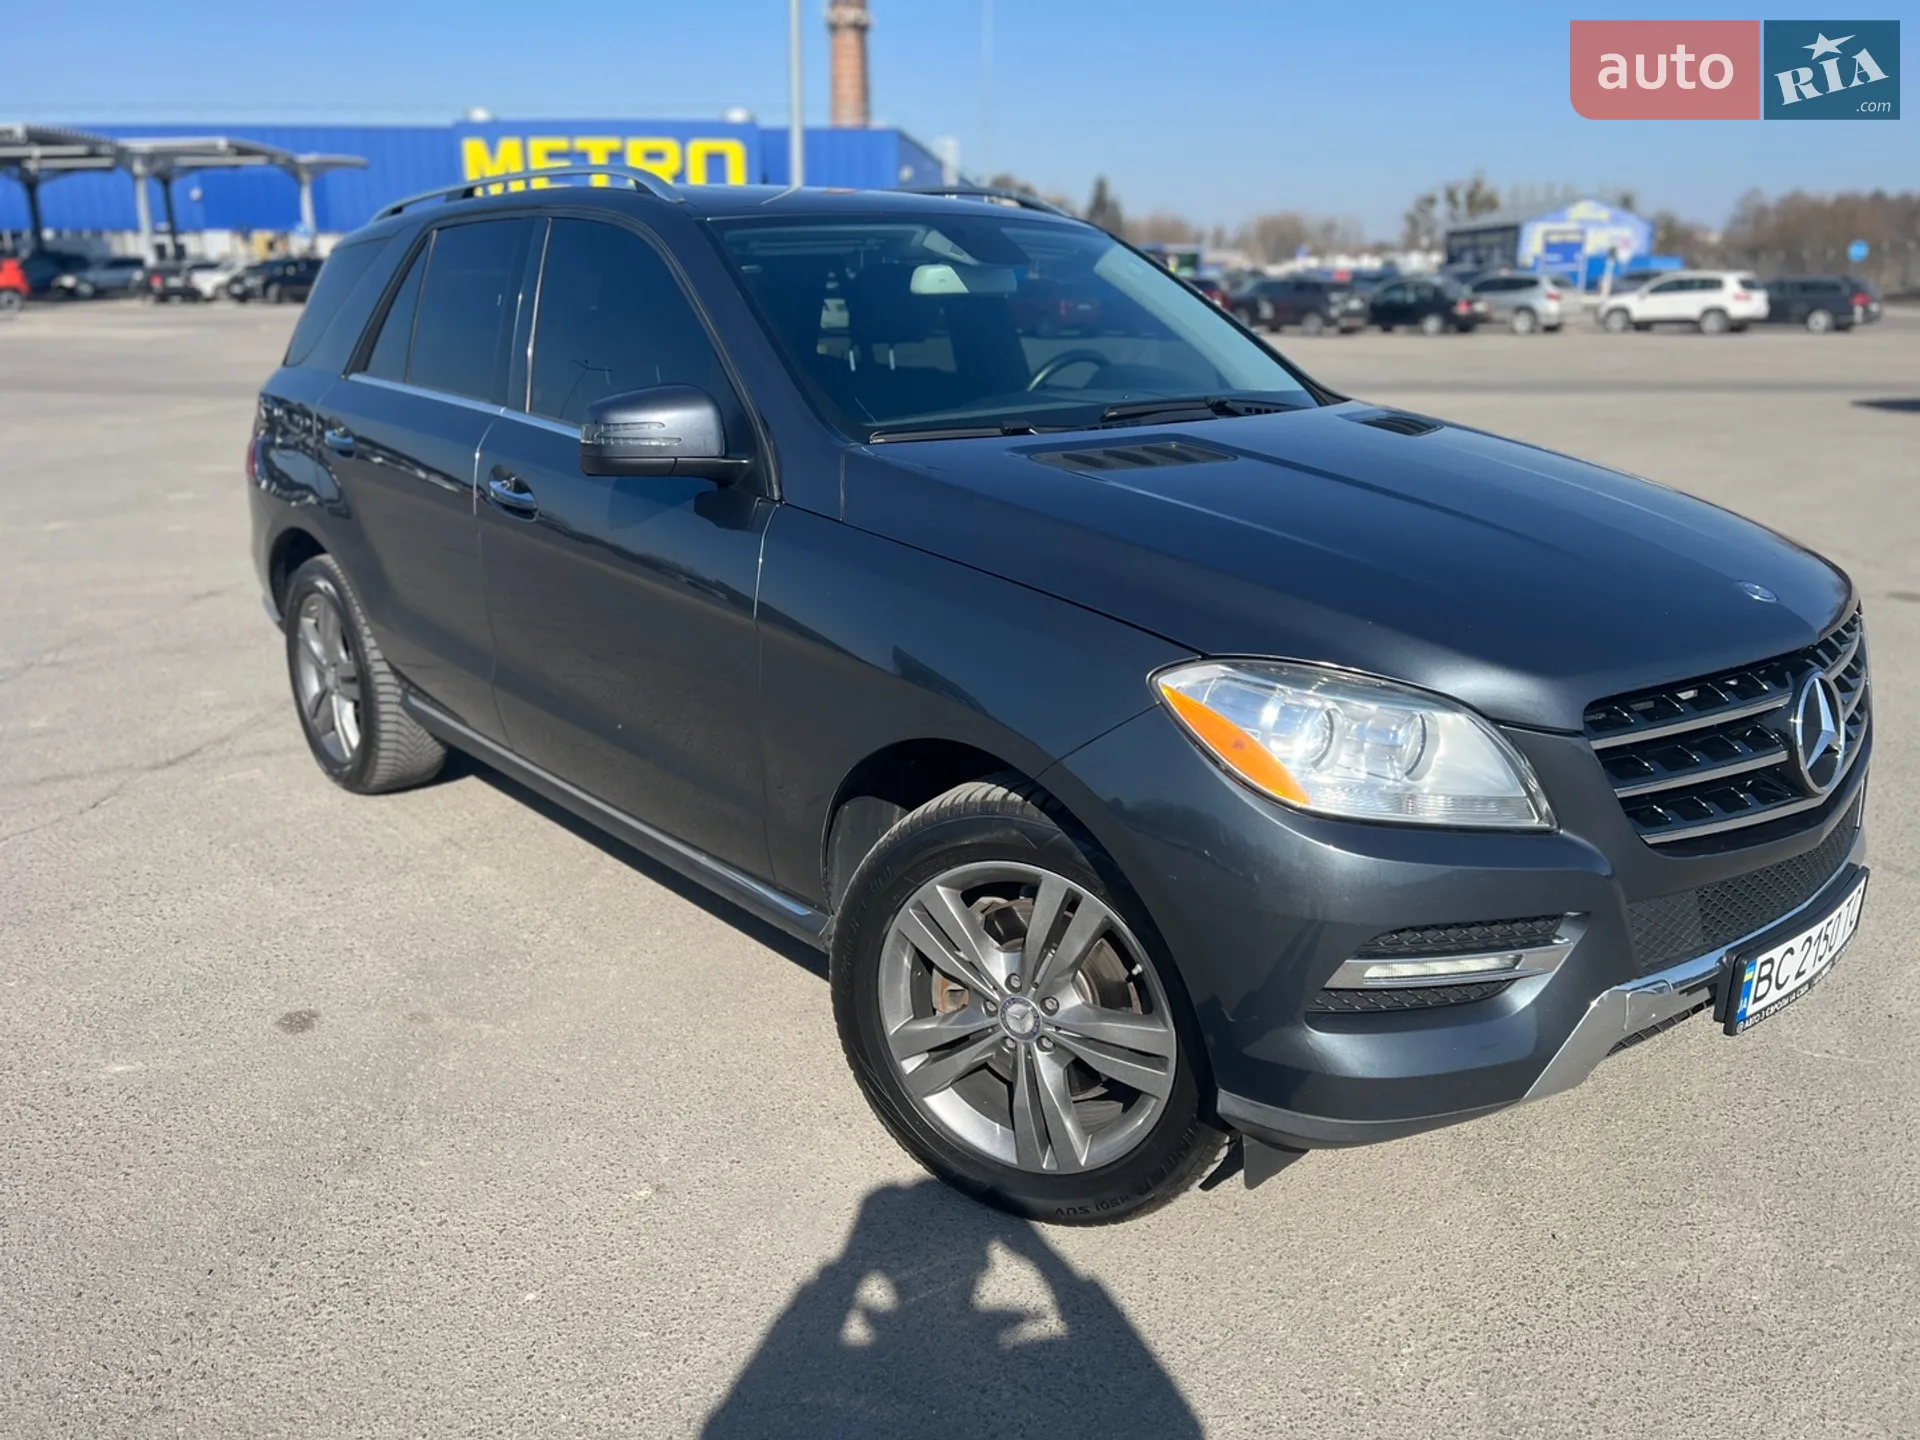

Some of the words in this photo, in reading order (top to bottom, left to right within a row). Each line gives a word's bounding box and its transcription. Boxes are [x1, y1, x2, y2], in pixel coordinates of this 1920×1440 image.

[462, 137, 747, 196] METRO
[1752, 946, 1795, 1005] BC
[1795, 910, 1842, 981] 2150
[1054, 1205, 1091, 1216] SUV
